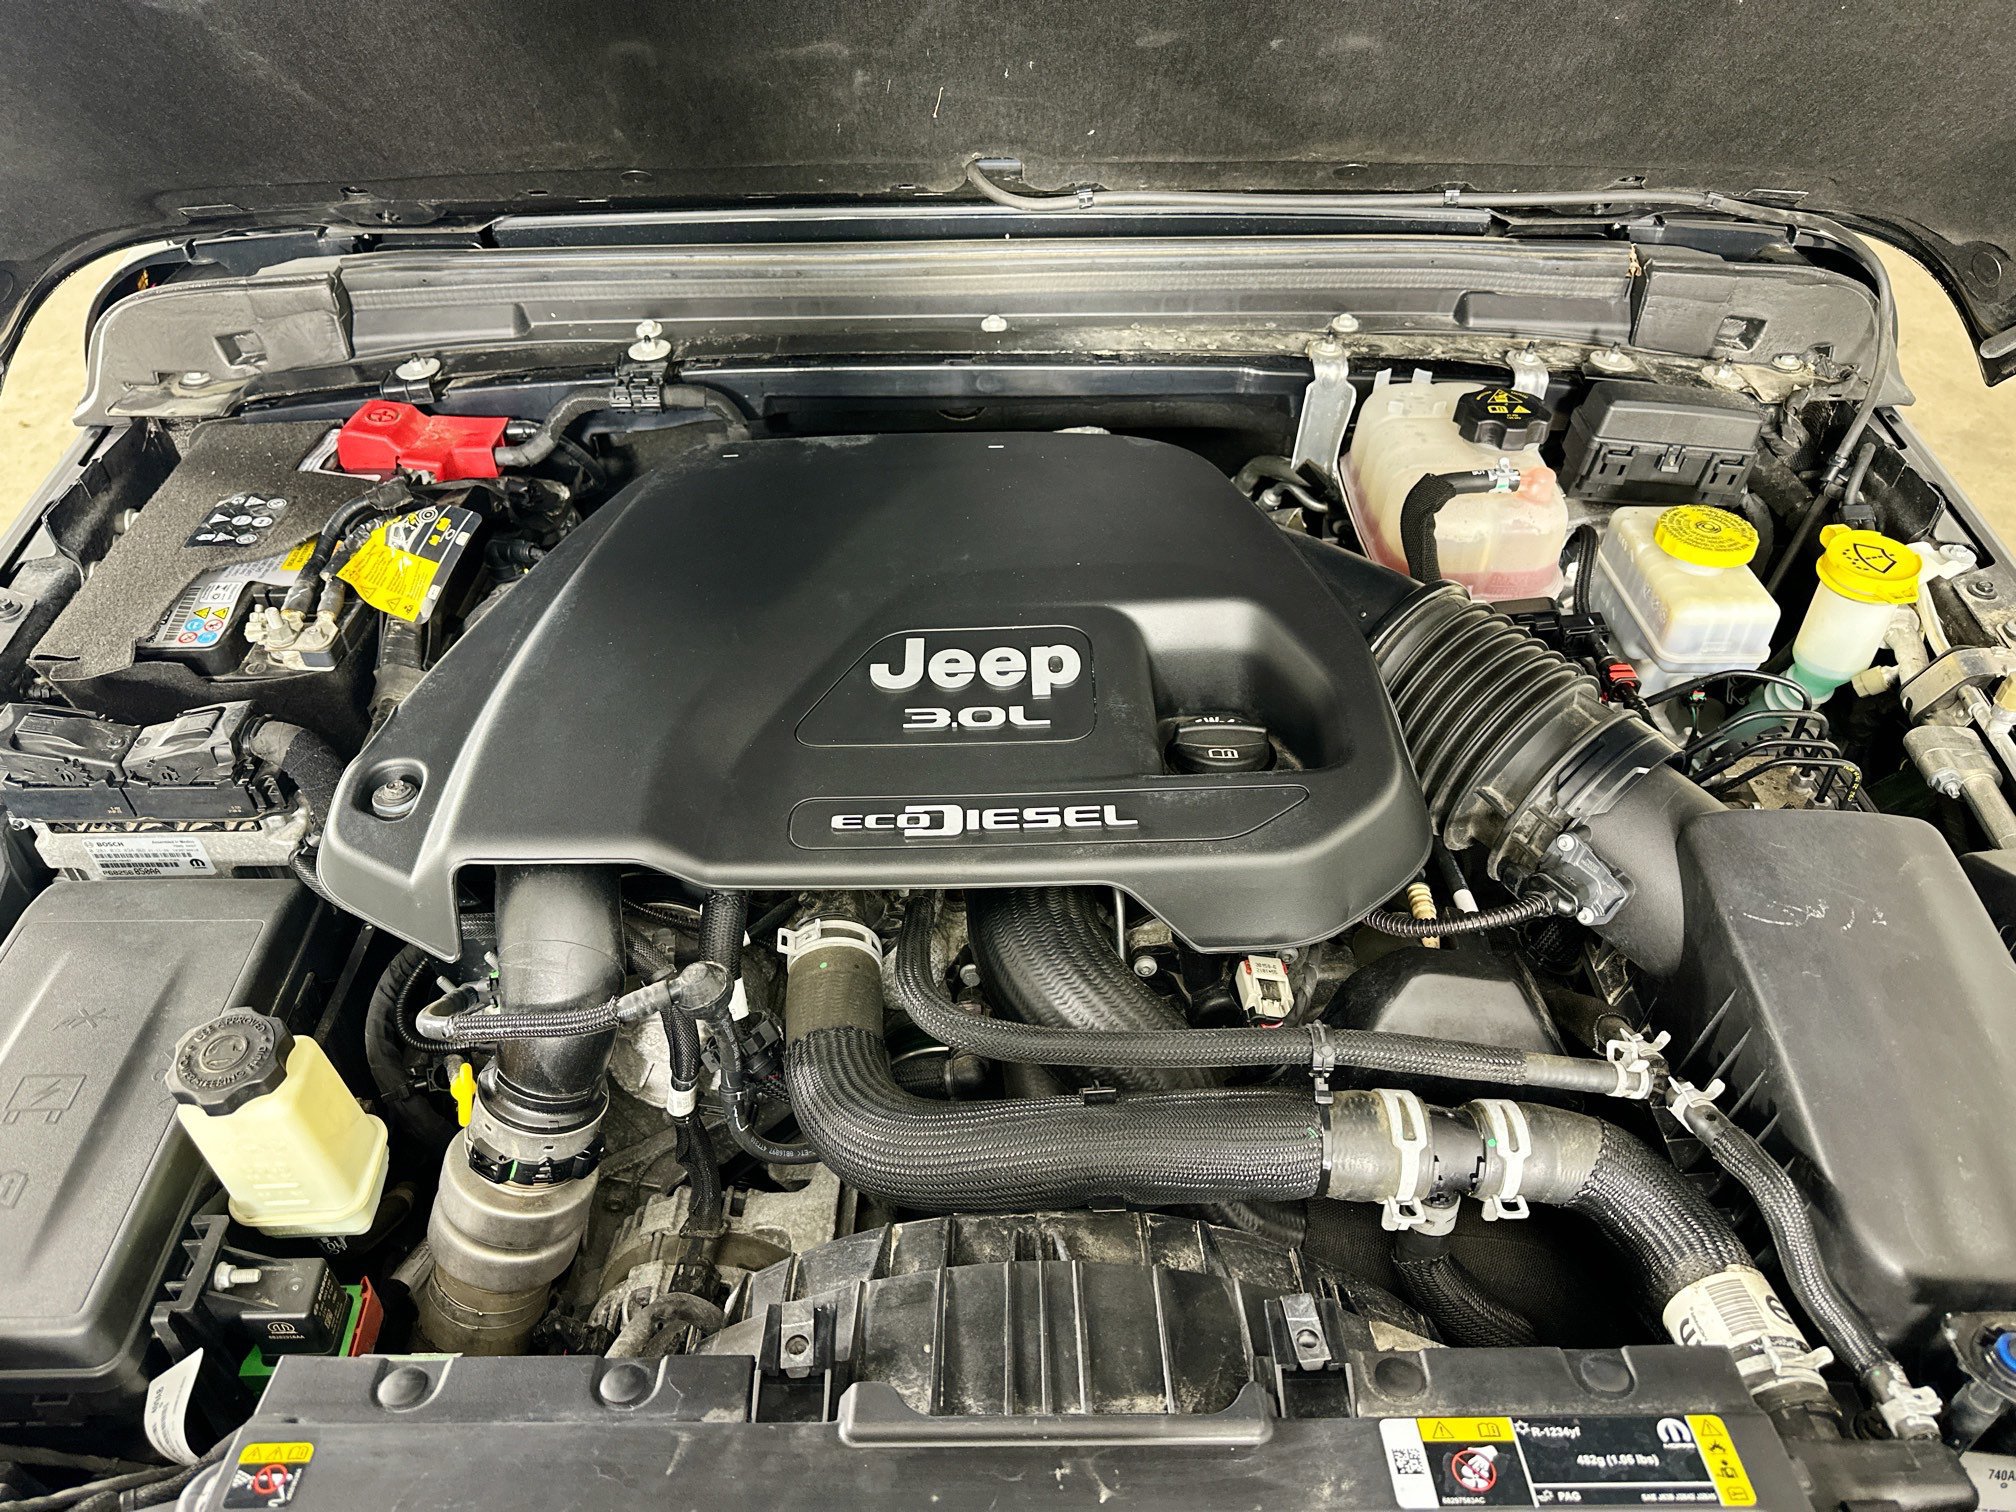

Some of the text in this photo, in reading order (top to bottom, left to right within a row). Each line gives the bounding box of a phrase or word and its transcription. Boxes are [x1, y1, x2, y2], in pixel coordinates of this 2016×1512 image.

[869, 637, 1082, 700] Jeep
[902, 705, 1051, 732] 3.0L
[218, 1016, 267, 1033] APPROVED
[1530, 1426, 1581, 1439] R-1234yf
[1988, 1468, 2016, 1481] 740A
[1557, 1491, 1582, 1502] PAG
